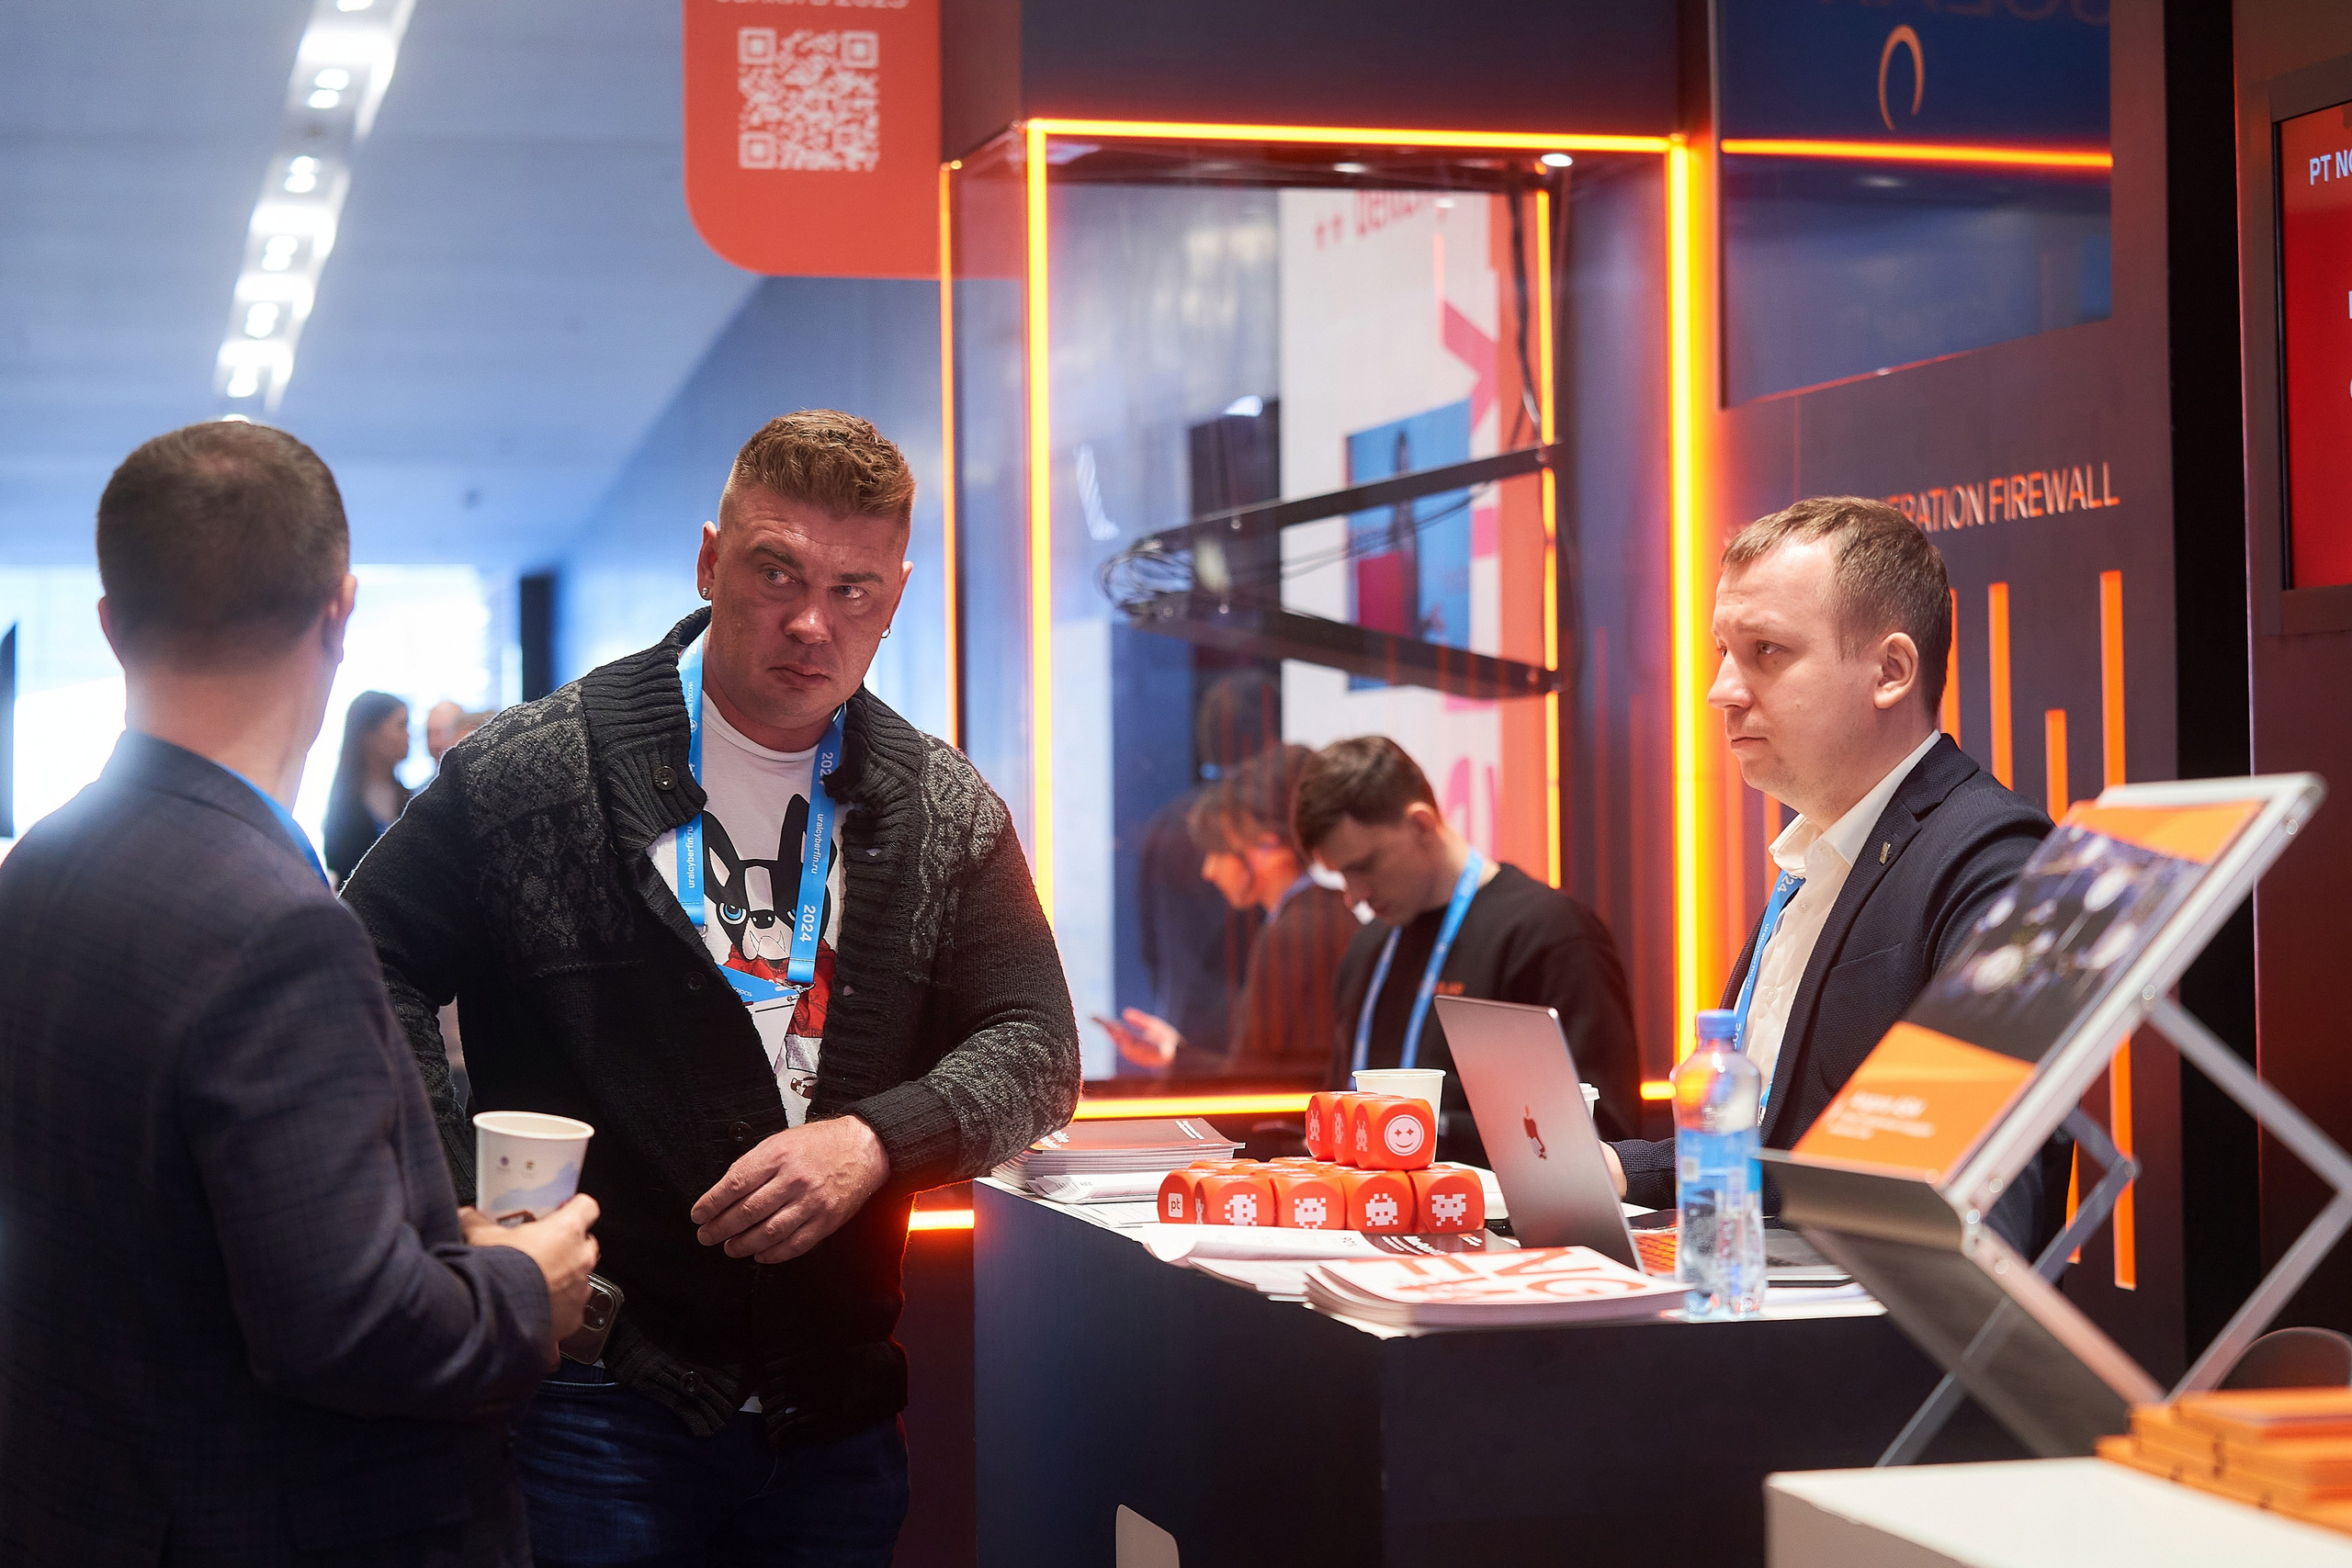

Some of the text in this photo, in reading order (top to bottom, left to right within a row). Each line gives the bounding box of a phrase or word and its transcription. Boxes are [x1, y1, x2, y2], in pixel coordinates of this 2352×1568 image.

[2309, 153, 2332, 186] PT
[1988, 461, 2120, 524] FIREWALL
[819, 752, 834, 785] 202
[684, 826, 695, 889] uralcyberfin.ru
[810, 813, 824, 874] uralcyberfin.ru
[799, 904, 816, 942] 2024
[1170, 1198, 1181, 1213] pt
